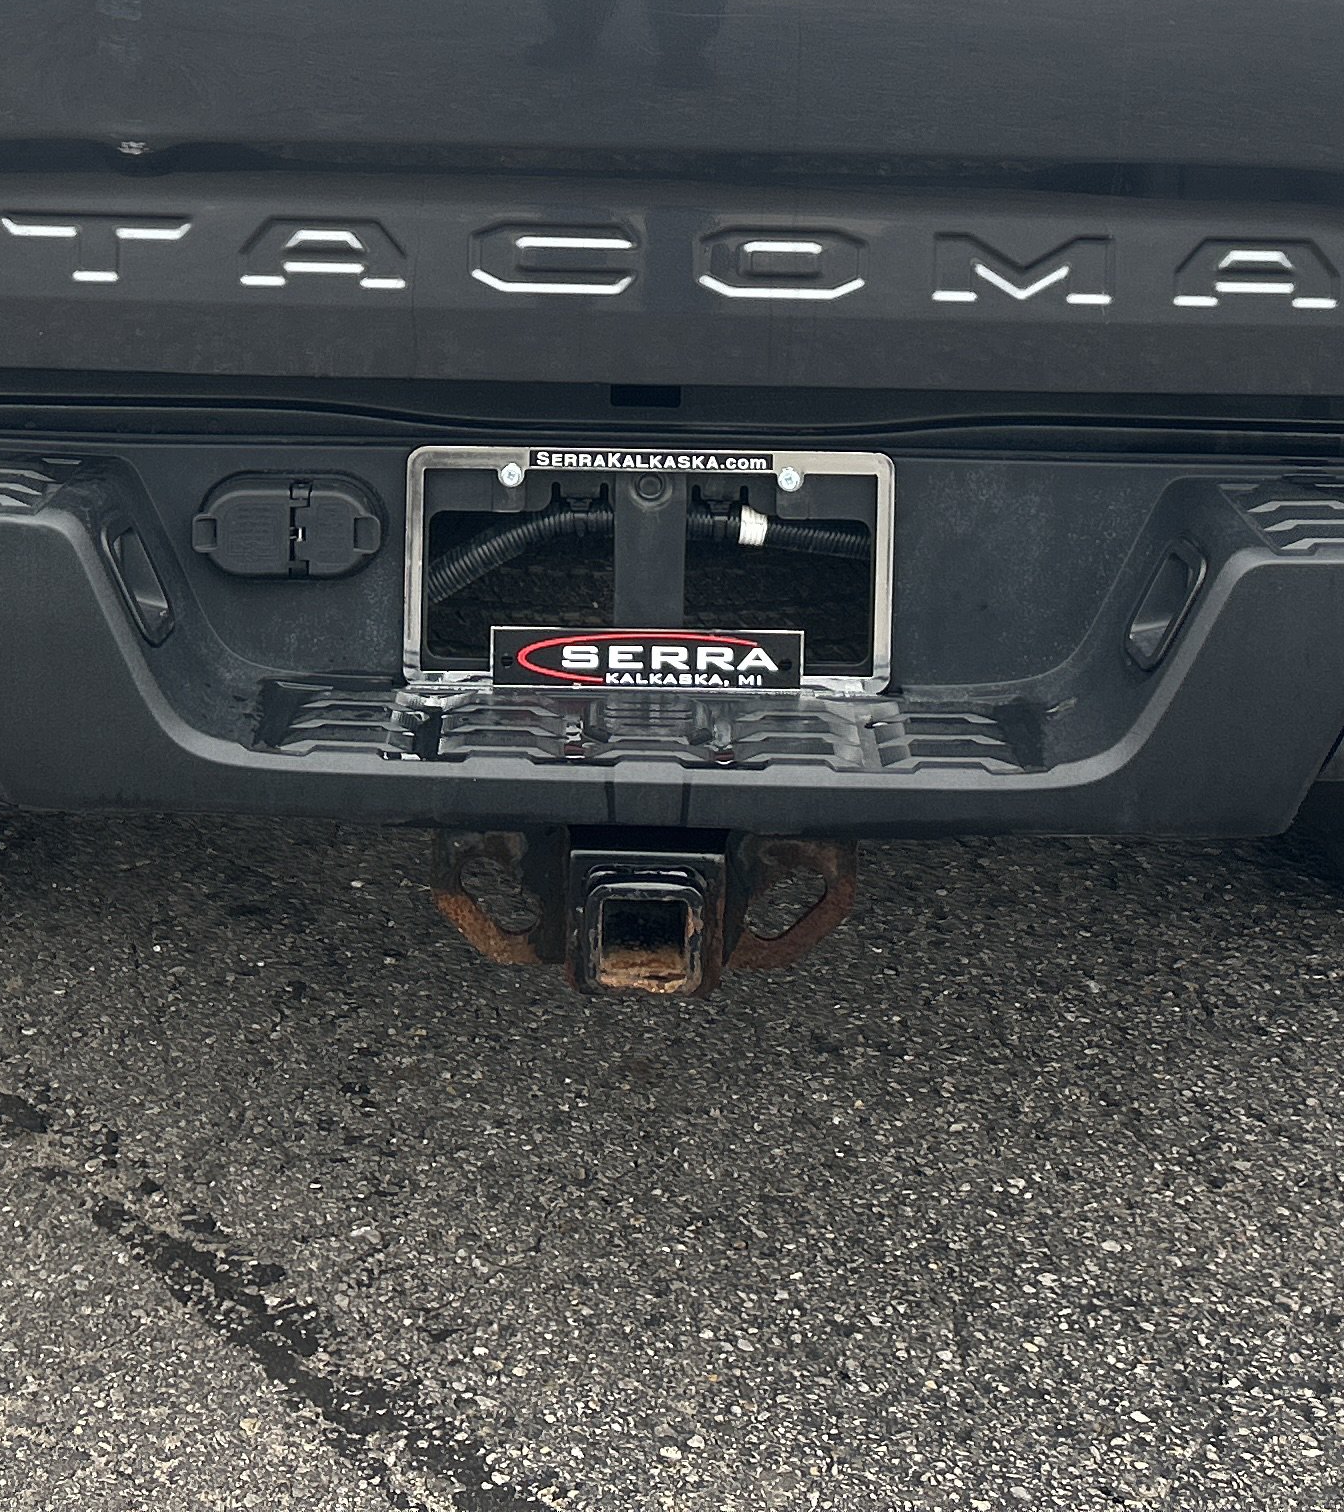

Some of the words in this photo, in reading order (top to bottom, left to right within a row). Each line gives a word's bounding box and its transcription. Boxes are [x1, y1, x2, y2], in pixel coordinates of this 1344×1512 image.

[0, 210, 1342, 310] TACOMA
[561, 645, 779, 671] SERRA
[605, 672, 730, 687] KALKASKA,
[738, 674, 762, 686] MI
